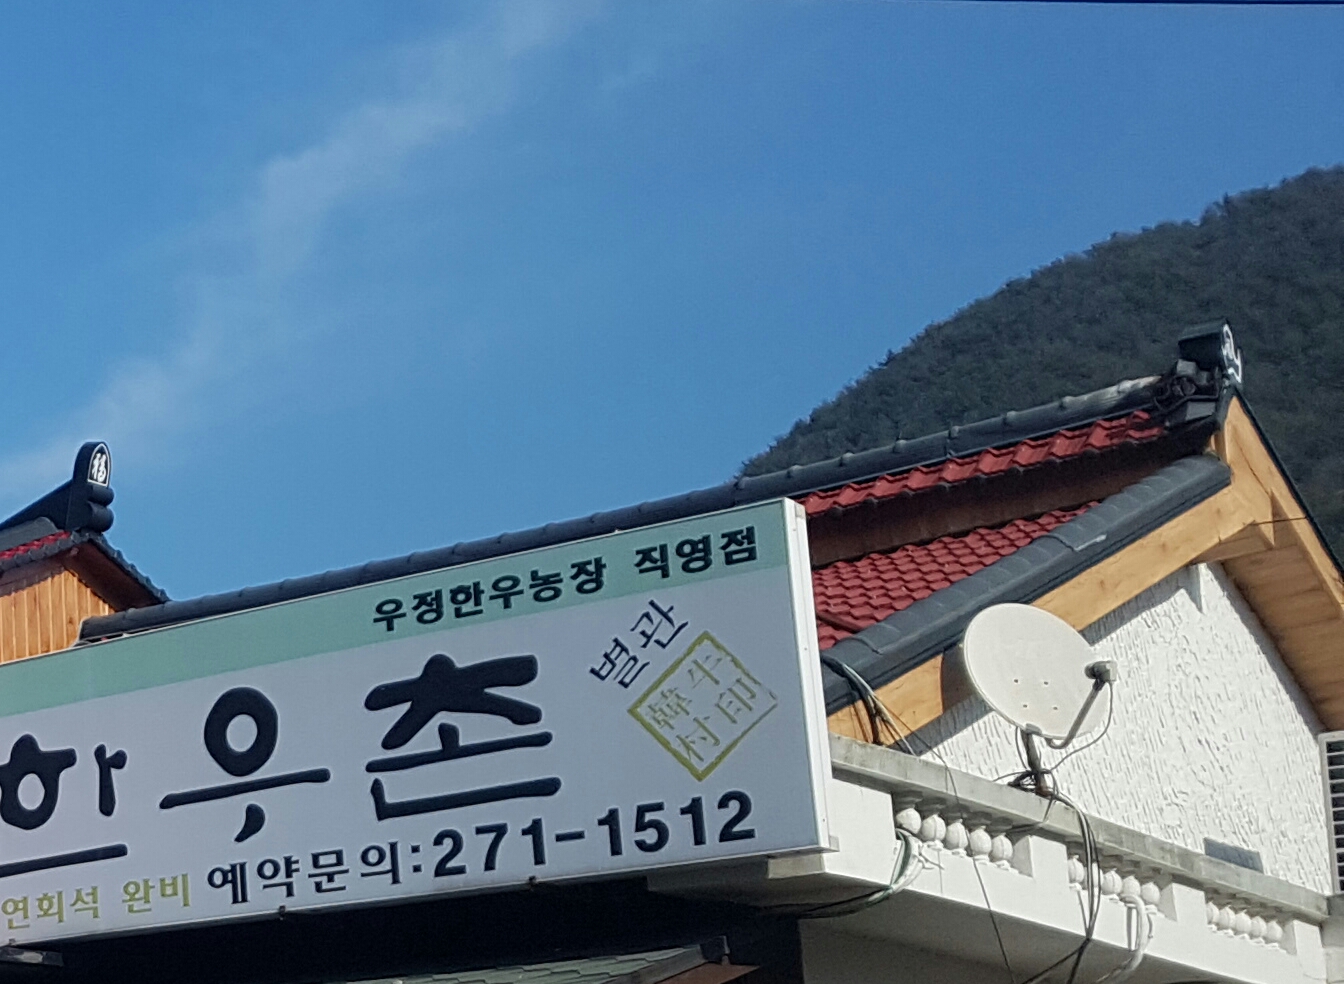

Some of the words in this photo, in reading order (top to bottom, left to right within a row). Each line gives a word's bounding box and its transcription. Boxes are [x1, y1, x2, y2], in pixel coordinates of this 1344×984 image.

[373, 557, 607, 632] 우정한우농장
[634, 526, 757, 580] 직영점
[589, 600, 689, 689] 별관
[0, 886, 100, 931] 연회석
[121, 873, 191, 914] 완비
[208, 790, 756, 906] 예약문의:271-1512
